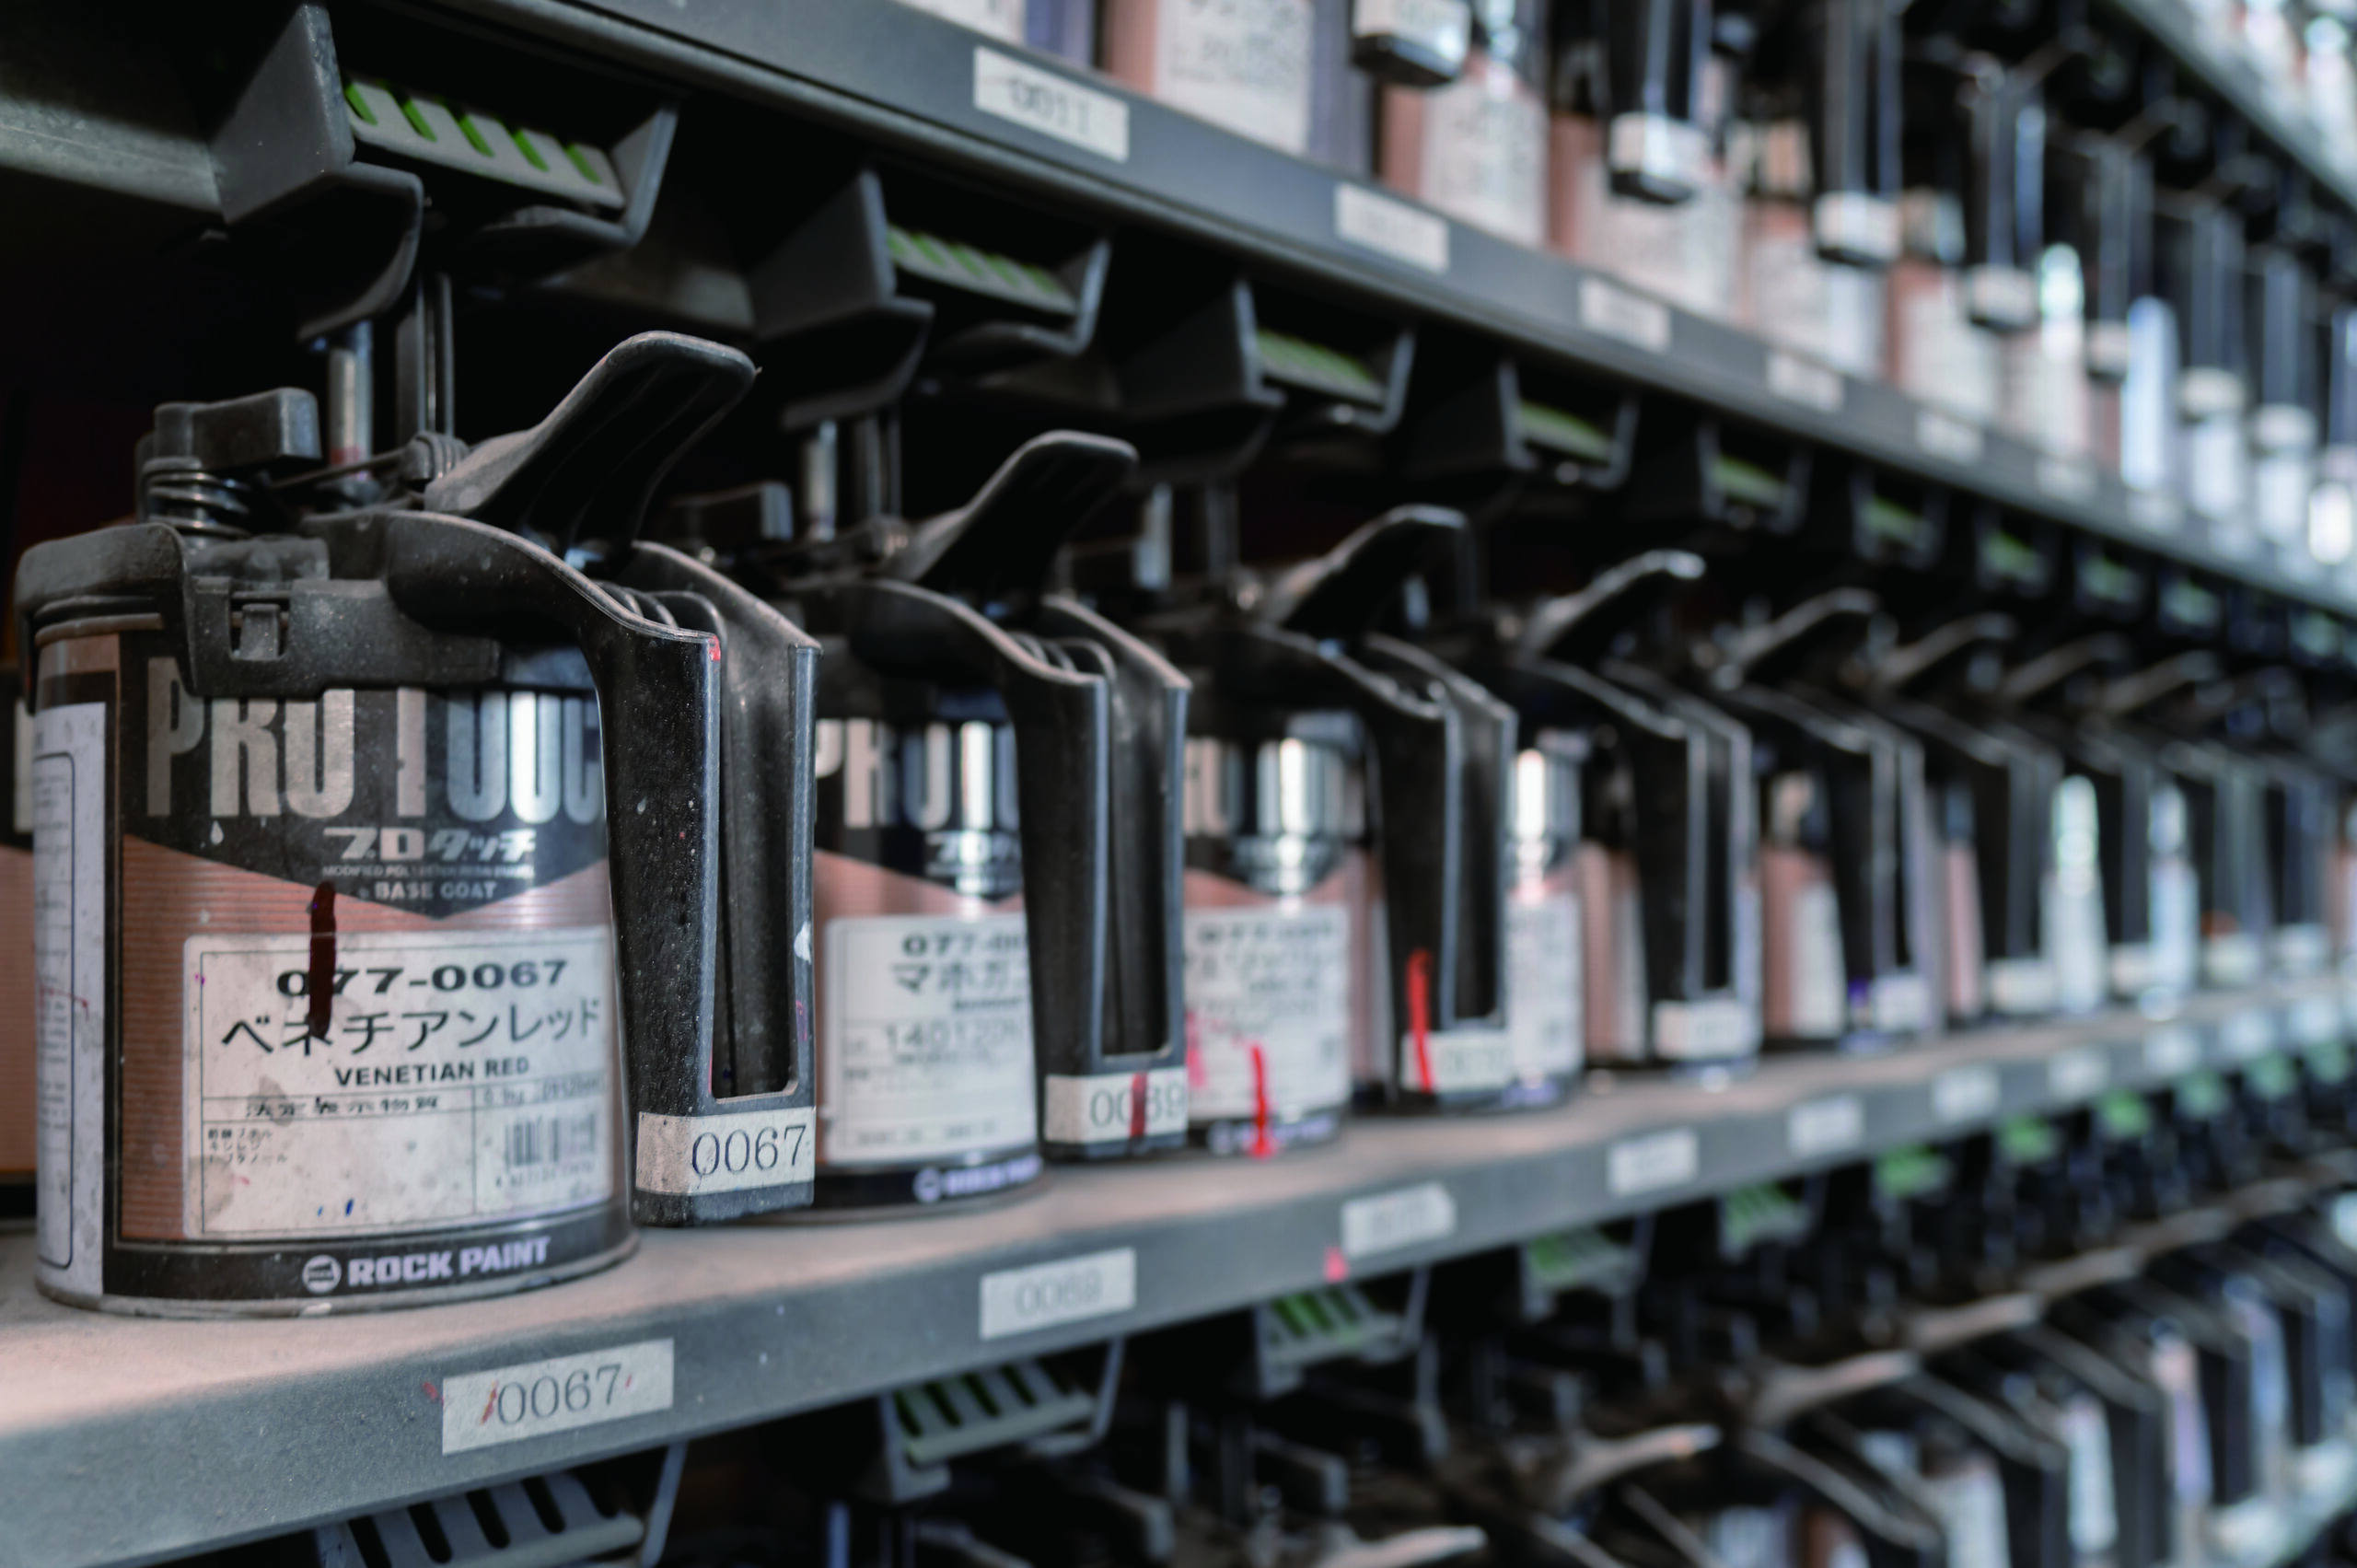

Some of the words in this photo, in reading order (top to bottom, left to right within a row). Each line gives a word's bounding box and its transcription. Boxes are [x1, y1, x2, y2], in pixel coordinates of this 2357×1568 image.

[375, 880, 434, 900] BASE
[440, 880, 497, 900] COAT
[334, 1061, 474, 1086] VENETIAN
[484, 1056, 530, 1076] RED
[691, 1123, 807, 1177] 0067
[347, 1252, 453, 1287] ROCK
[461, 1236, 552, 1276] PAINT
[497, 1362, 622, 1426] 0067
